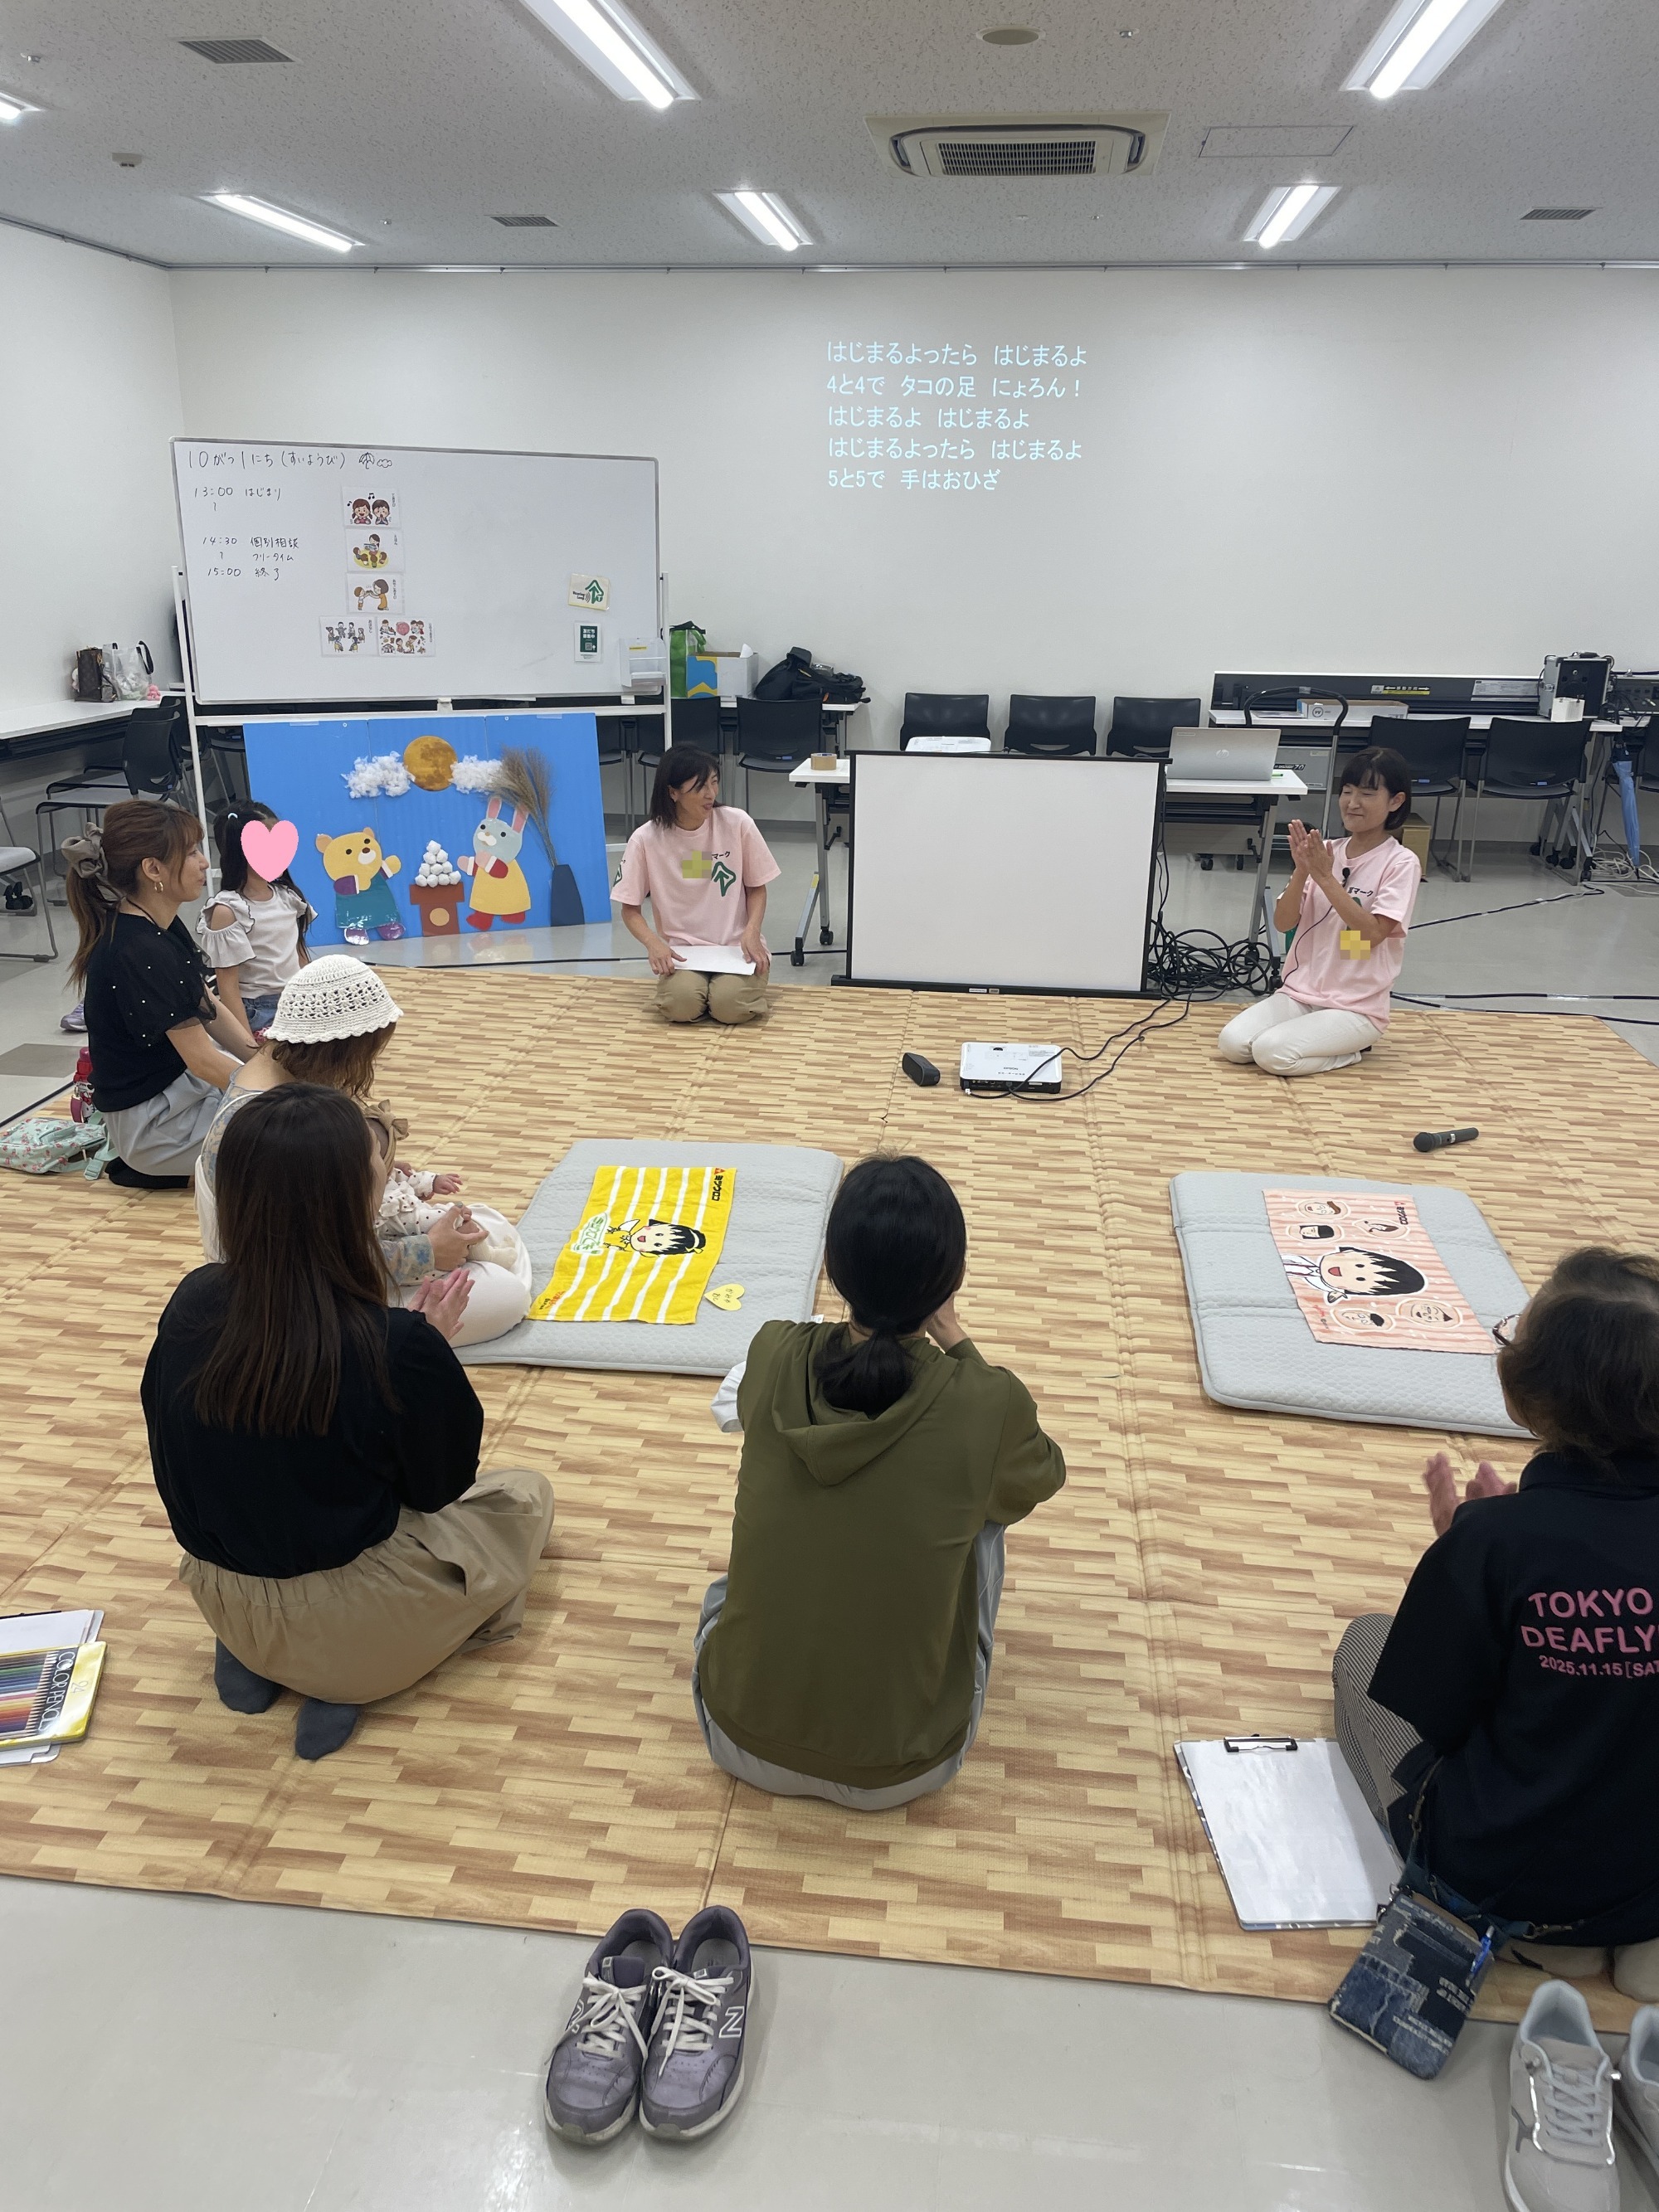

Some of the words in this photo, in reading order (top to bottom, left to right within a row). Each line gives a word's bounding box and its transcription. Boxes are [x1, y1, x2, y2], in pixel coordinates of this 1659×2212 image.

[828, 341, 977, 366] はじまるよったら
[995, 344, 1087, 367] はじまるよ
[827, 373, 885, 396] 4と4で
[901, 375, 976, 397] タコの足
[828, 406, 922, 428] はじまるよ
[938, 407, 1029, 429] はじまるよ
[828, 437, 975, 459] はじまるよったら
[991, 440, 1082, 460] はじまるよ
[828, 468, 885, 489] 5と5で
[900, 469, 1000, 490] 手はおひざ
[246, 488, 281, 501] はじまり
[1527, 1587, 1654, 1618] TOKYO
[1520, 1624, 1659, 1654] DEAFLY
[51, 1651, 75, 1689] COLOR
